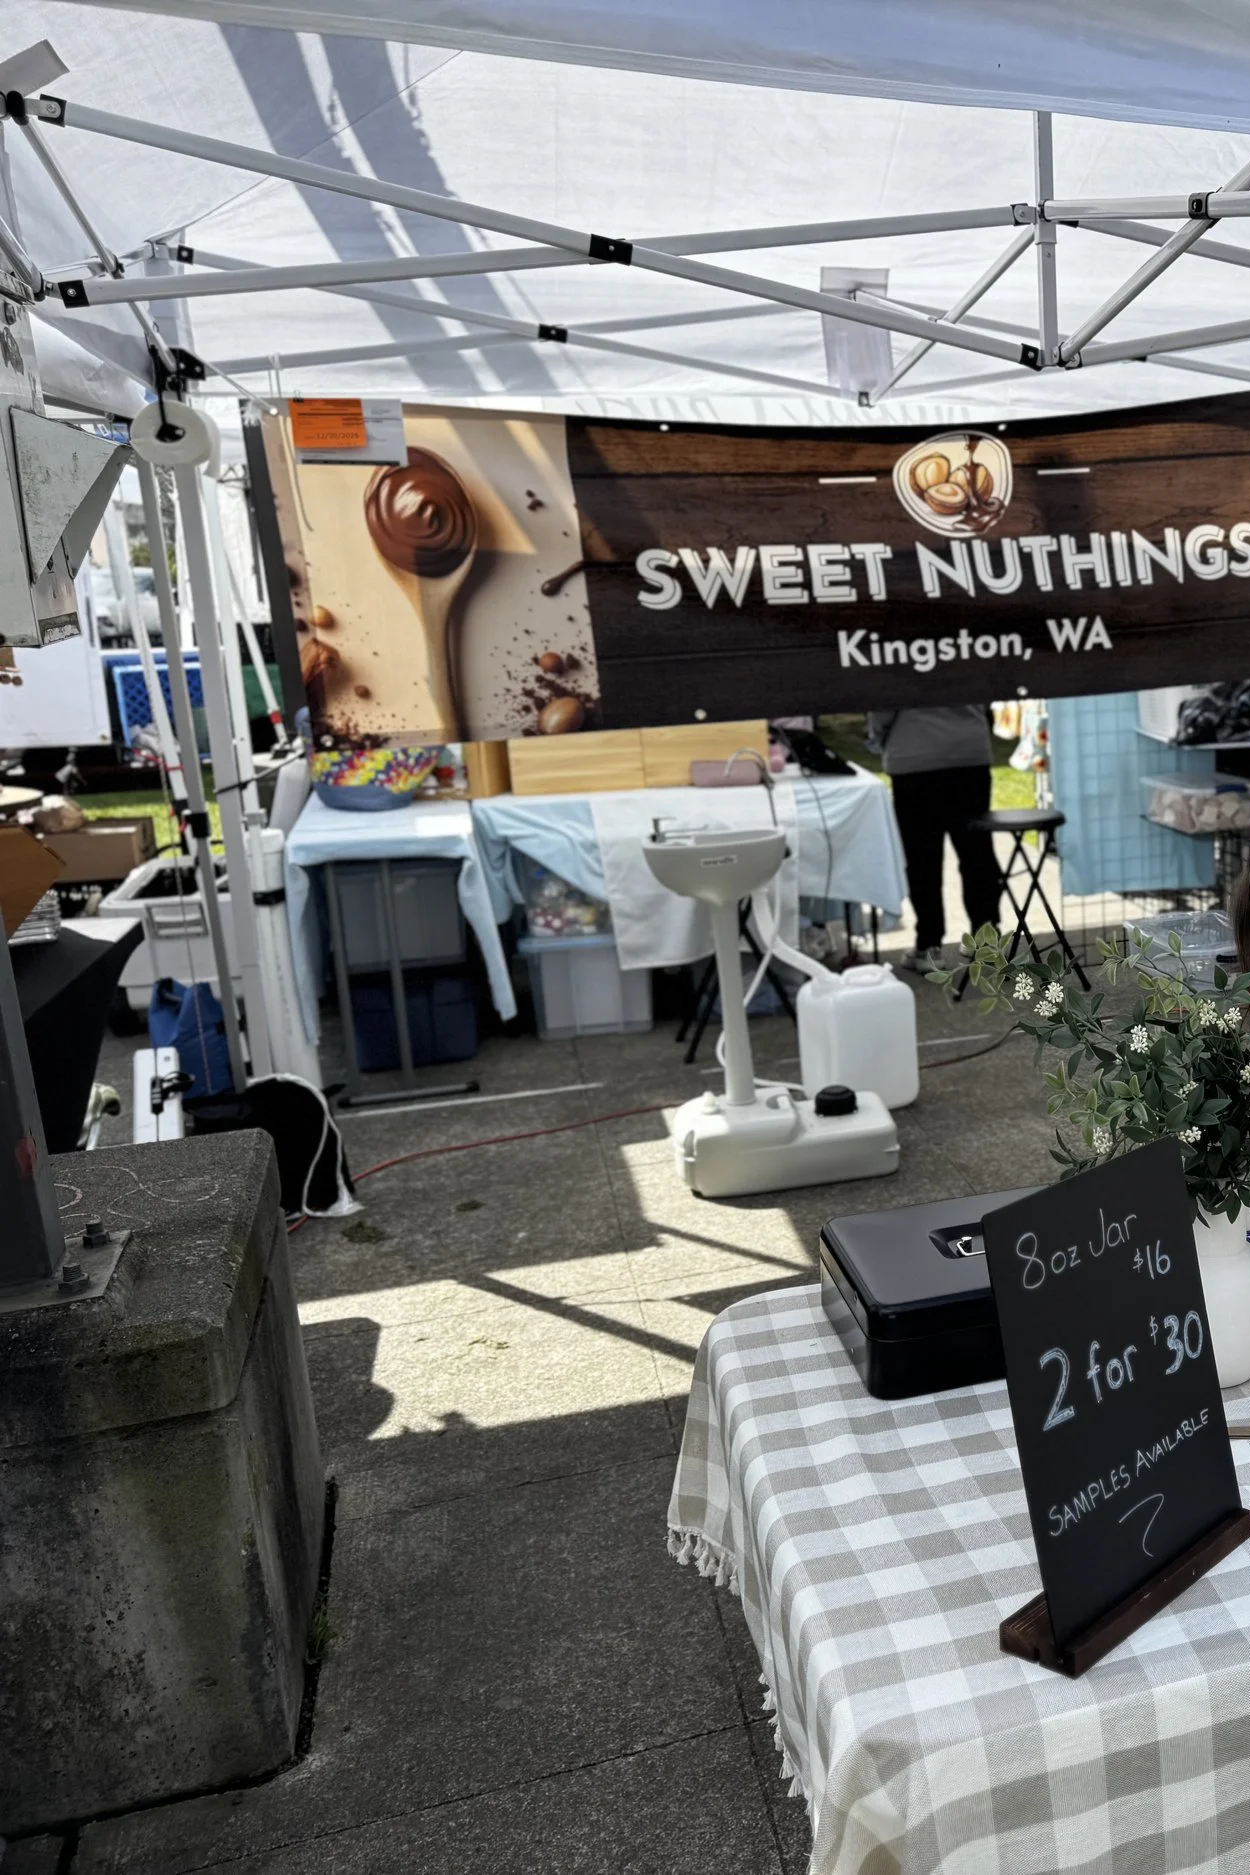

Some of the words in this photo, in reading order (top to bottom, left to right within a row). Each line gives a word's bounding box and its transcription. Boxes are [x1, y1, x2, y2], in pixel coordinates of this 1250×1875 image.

[636, 543, 893, 610] SWEET
[837, 628, 1032, 672] Kingston,
[1046, 615, 1113, 653] WA
[1089, 1207, 1138, 1257] Jar
[1132, 1239, 1172, 1281] $16
[1039, 1347, 1077, 1432] 2
[1086, 1340, 1138, 1404] for
[1149, 1310, 1204, 1376] $30
